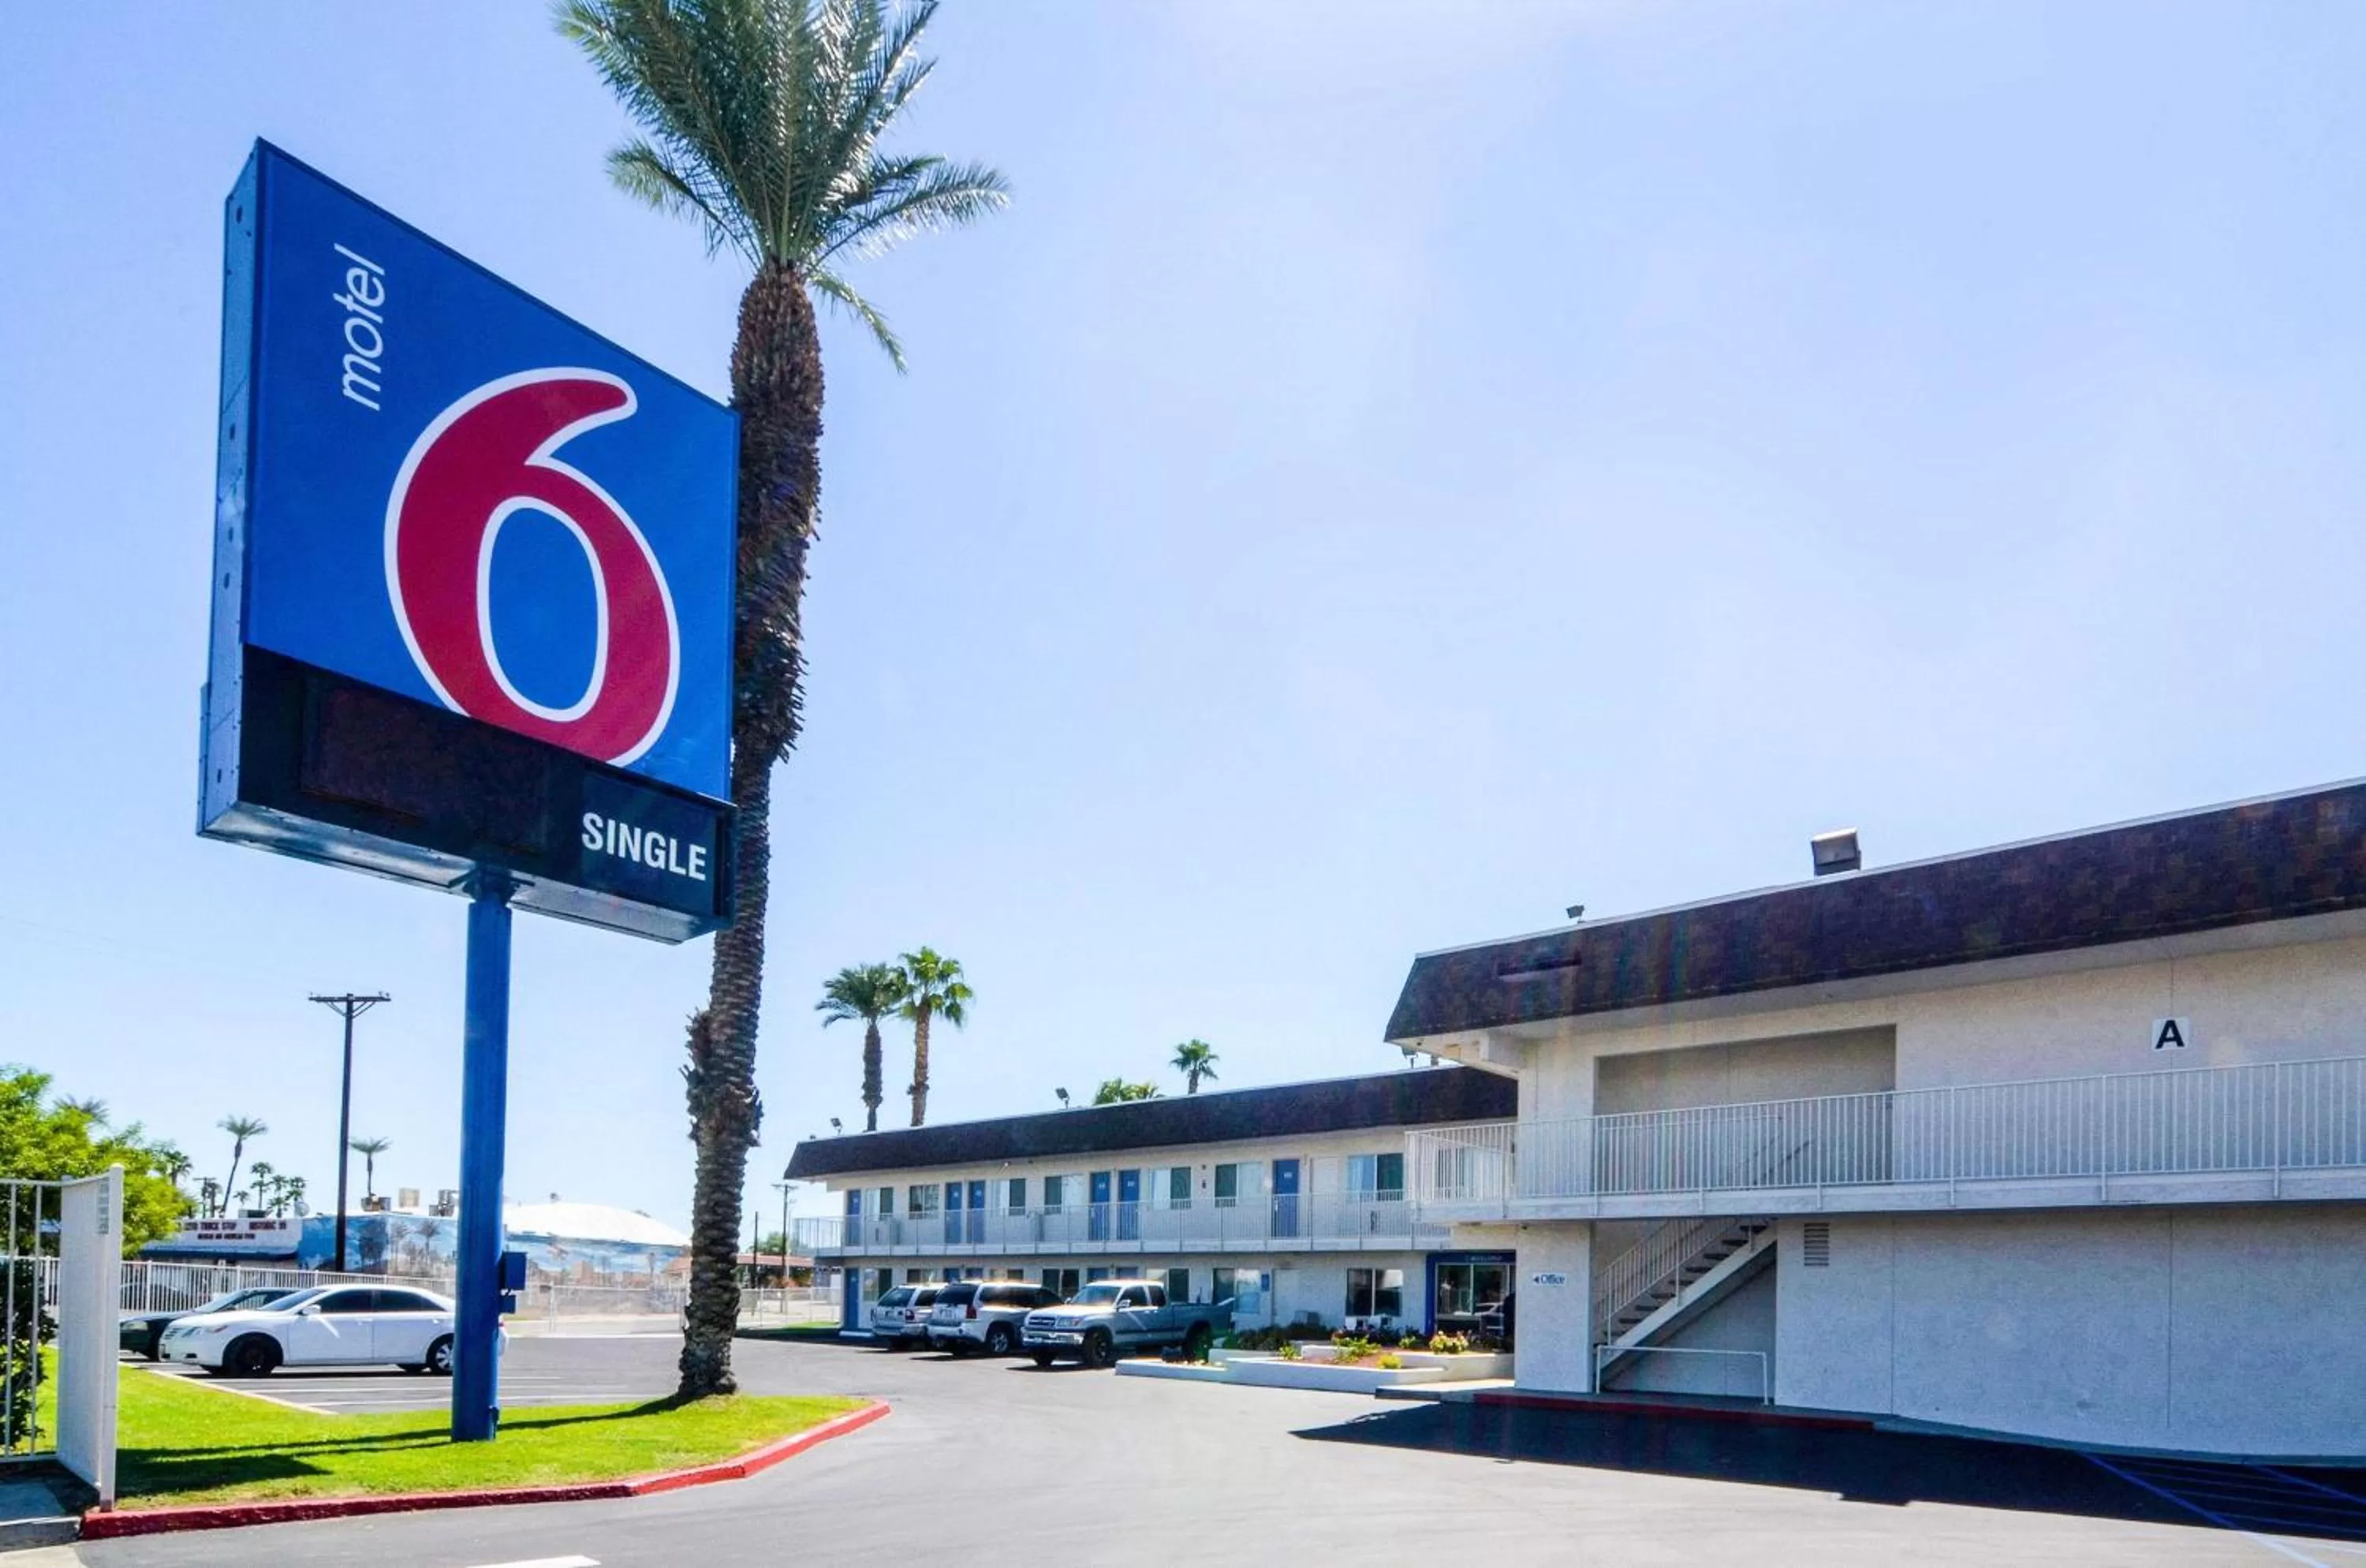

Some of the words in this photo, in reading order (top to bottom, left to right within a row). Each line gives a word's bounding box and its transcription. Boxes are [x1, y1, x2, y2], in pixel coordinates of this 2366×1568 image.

[333, 244, 385, 412] motel
[383, 366, 681, 768] 6
[581, 811, 707, 882] SINGLE
[2155, 1019, 2185, 1050] A
[1540, 1274, 1566, 1285] Office
